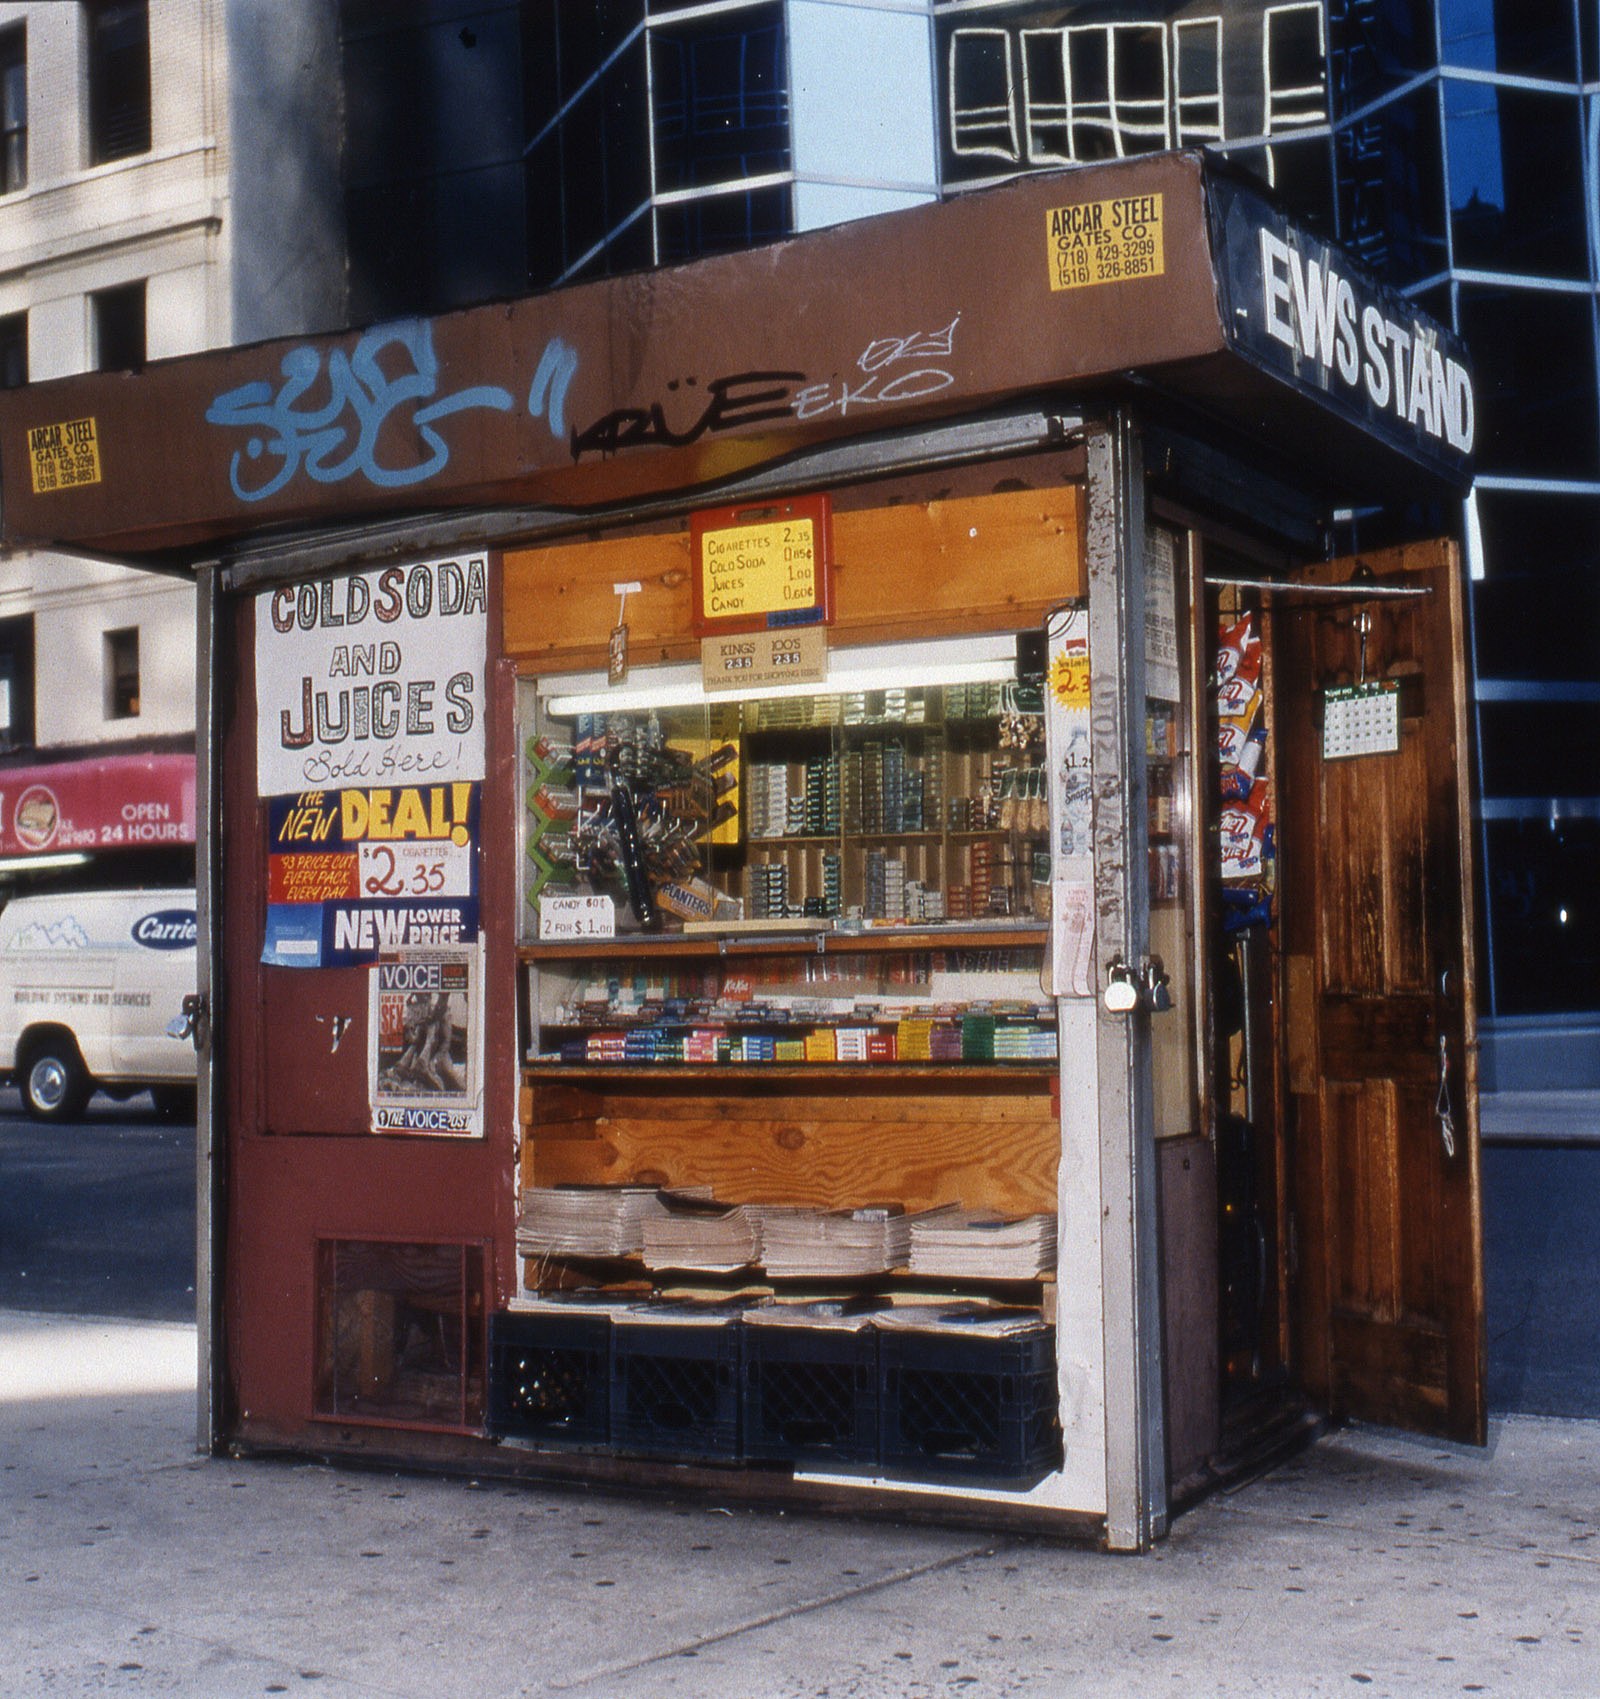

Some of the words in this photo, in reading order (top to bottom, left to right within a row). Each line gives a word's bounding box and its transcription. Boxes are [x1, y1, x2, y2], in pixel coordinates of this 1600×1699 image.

[1052, 204, 1102, 237] ARCAR
[1112, 197, 1158, 227] STEEL
[1057, 230, 1111, 250] GATES
[1122, 225, 1152, 240] CO.
[1057, 248, 1088, 268] (718)
[1096, 240, 1155, 262] 429-3299
[1059, 265, 1090, 285] (516)
[1097, 258, 1155, 280] 326-8851
[31, 426, 62, 451] ARCAR
[66, 420, 94, 445] STEEL
[36, 446, 68, 462] GATES
[74, 443, 93, 455] CO.
[708, 538, 770, 555] CIGARETTES
[711, 577, 744, 593] JUICES
[271, 577, 371, 634] COLD
[373, 560, 488, 624] SODA
[711, 597, 745, 612] CANDY
[329, 641, 402, 678] AND
[720, 642, 756, 656] KINGS
[1057, 669, 1090, 693] 2.3
[281, 672, 474, 751] JUICES
[302, 749, 371, 783] Sold
[374, 742, 463, 777] Here!
[297, 791, 326, 807] THE
[121, 803, 169, 820] OPEN
[278, 807, 337, 842] NEW
[341, 782, 472, 848] DEAL!
[101, 824, 125, 842] 24
[128, 822, 191, 841] HOURS
[297, 855, 332, 869] PRICE
[283, 870, 317, 885] EVERY
[287, 885, 321, 900] EVERY
[662, 882, 712, 915] PLANTERS
[553, 899, 580, 910] CANDY
[138, 917, 197, 939] Carrie
[334, 909, 408, 950] NEW
[409, 909, 461, 923] LOWER
[409, 924, 460, 944] PRICE
[545, 919, 552, 934] 2
[555, 923, 572, 932] FOR
[383, 965, 439, 989] VOICE
[92, 993, 110, 1005] AND
[381, 1003, 404, 1035] SEX
[407, 1110, 448, 1130] VOICE
